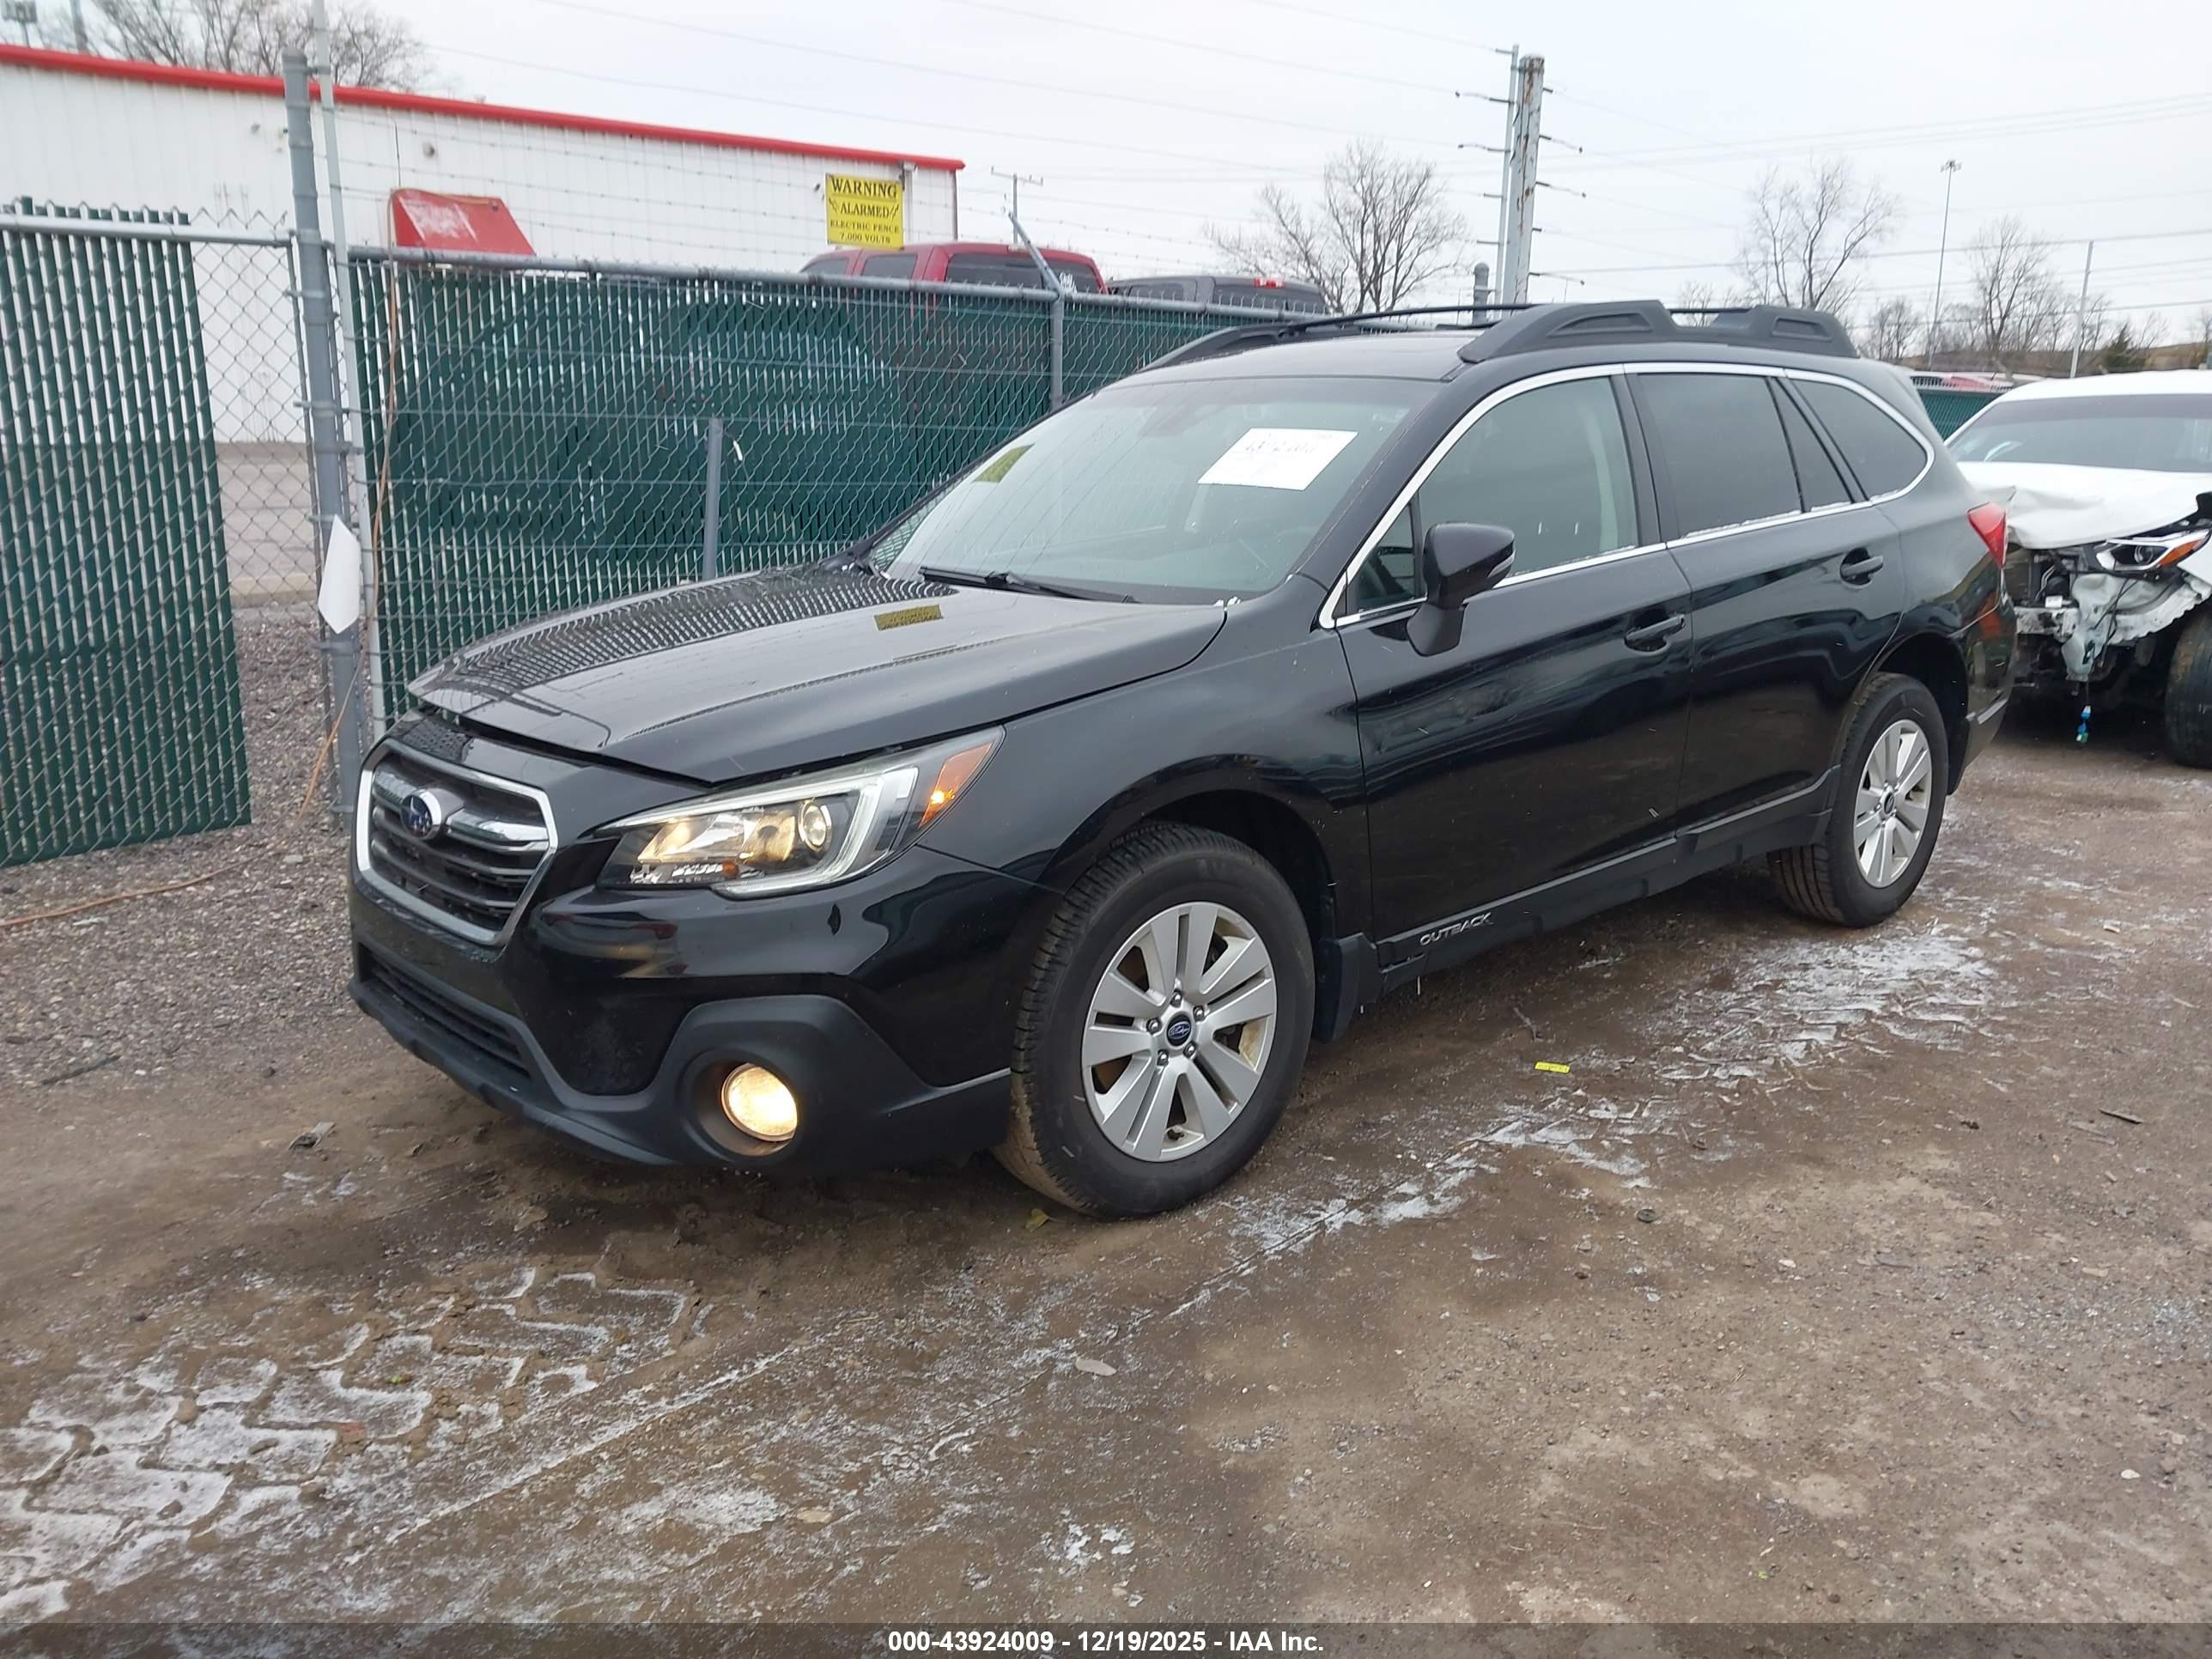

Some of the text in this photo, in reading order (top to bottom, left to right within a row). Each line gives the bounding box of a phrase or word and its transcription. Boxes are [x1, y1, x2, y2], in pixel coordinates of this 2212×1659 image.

[831, 177, 897, 199] WARNING
[840, 203, 890, 219] ALARMED
[830, 219, 899, 234] ELECTRIC FENCE
[840, 232, 891, 244] 7,000 VOLTS
[1419, 912, 1494, 945] OUTBACK
